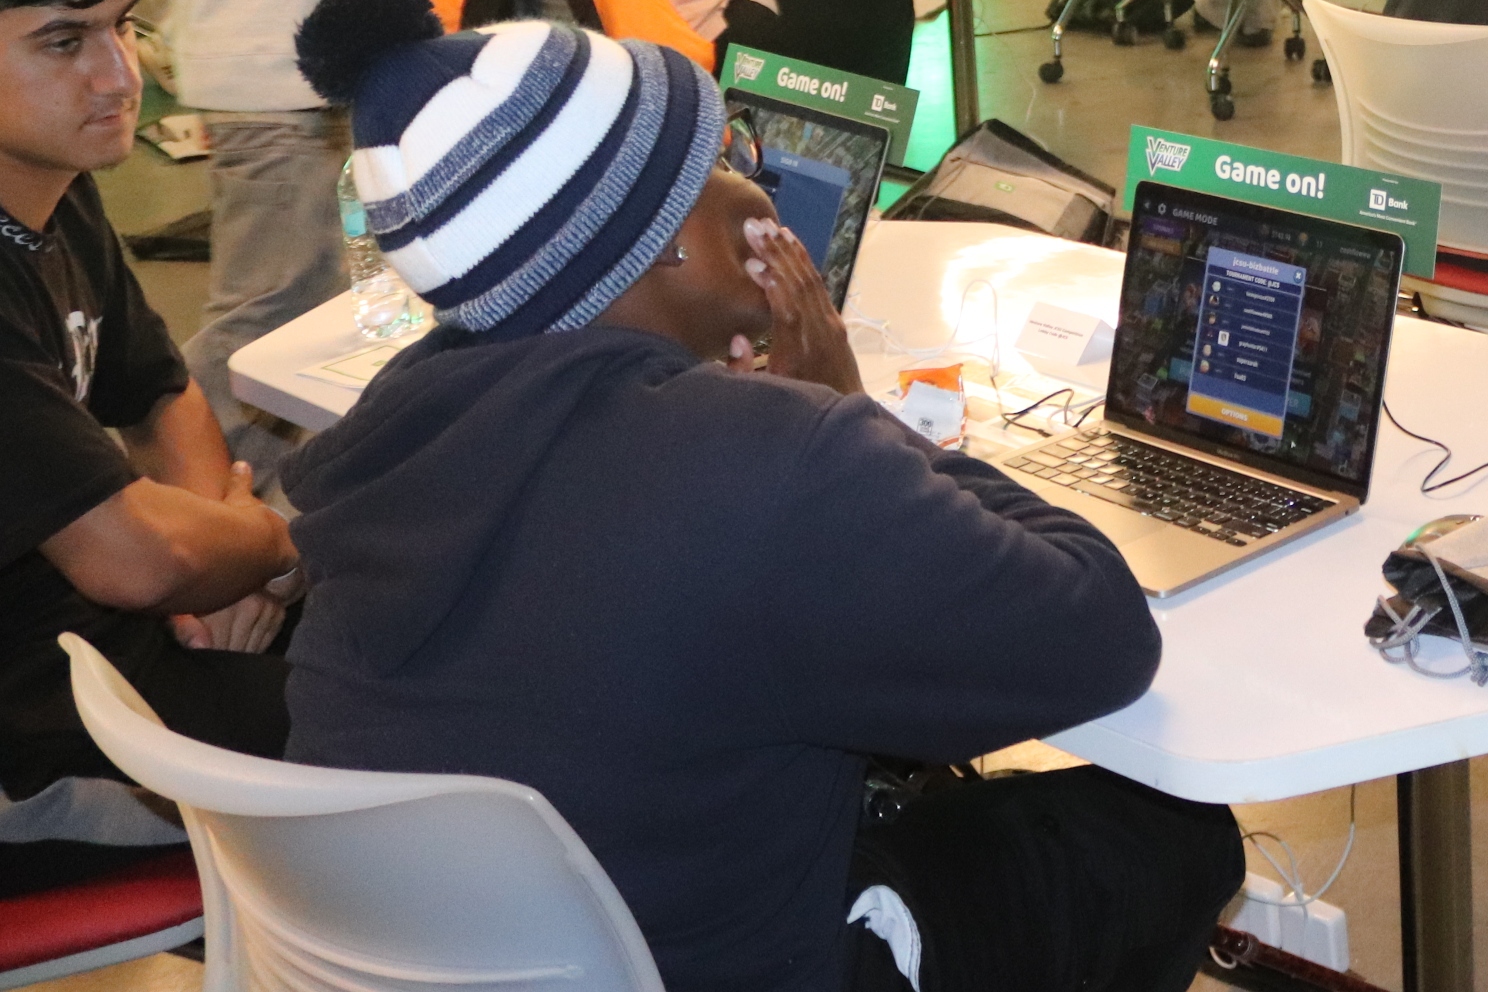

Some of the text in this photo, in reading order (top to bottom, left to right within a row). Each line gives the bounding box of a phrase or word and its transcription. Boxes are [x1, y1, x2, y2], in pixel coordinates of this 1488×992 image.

[777, 67, 848, 103] Game on!
[1149, 138, 1189, 157] VENTURE
[1147, 151, 1184, 172] VALLEY
[1215, 155, 1326, 199] Game on!
[1388, 198, 1409, 210] Bank
[1172, 208, 1218, 226] GAME MODE
[1221, 408, 1249, 421] OPTIONS
